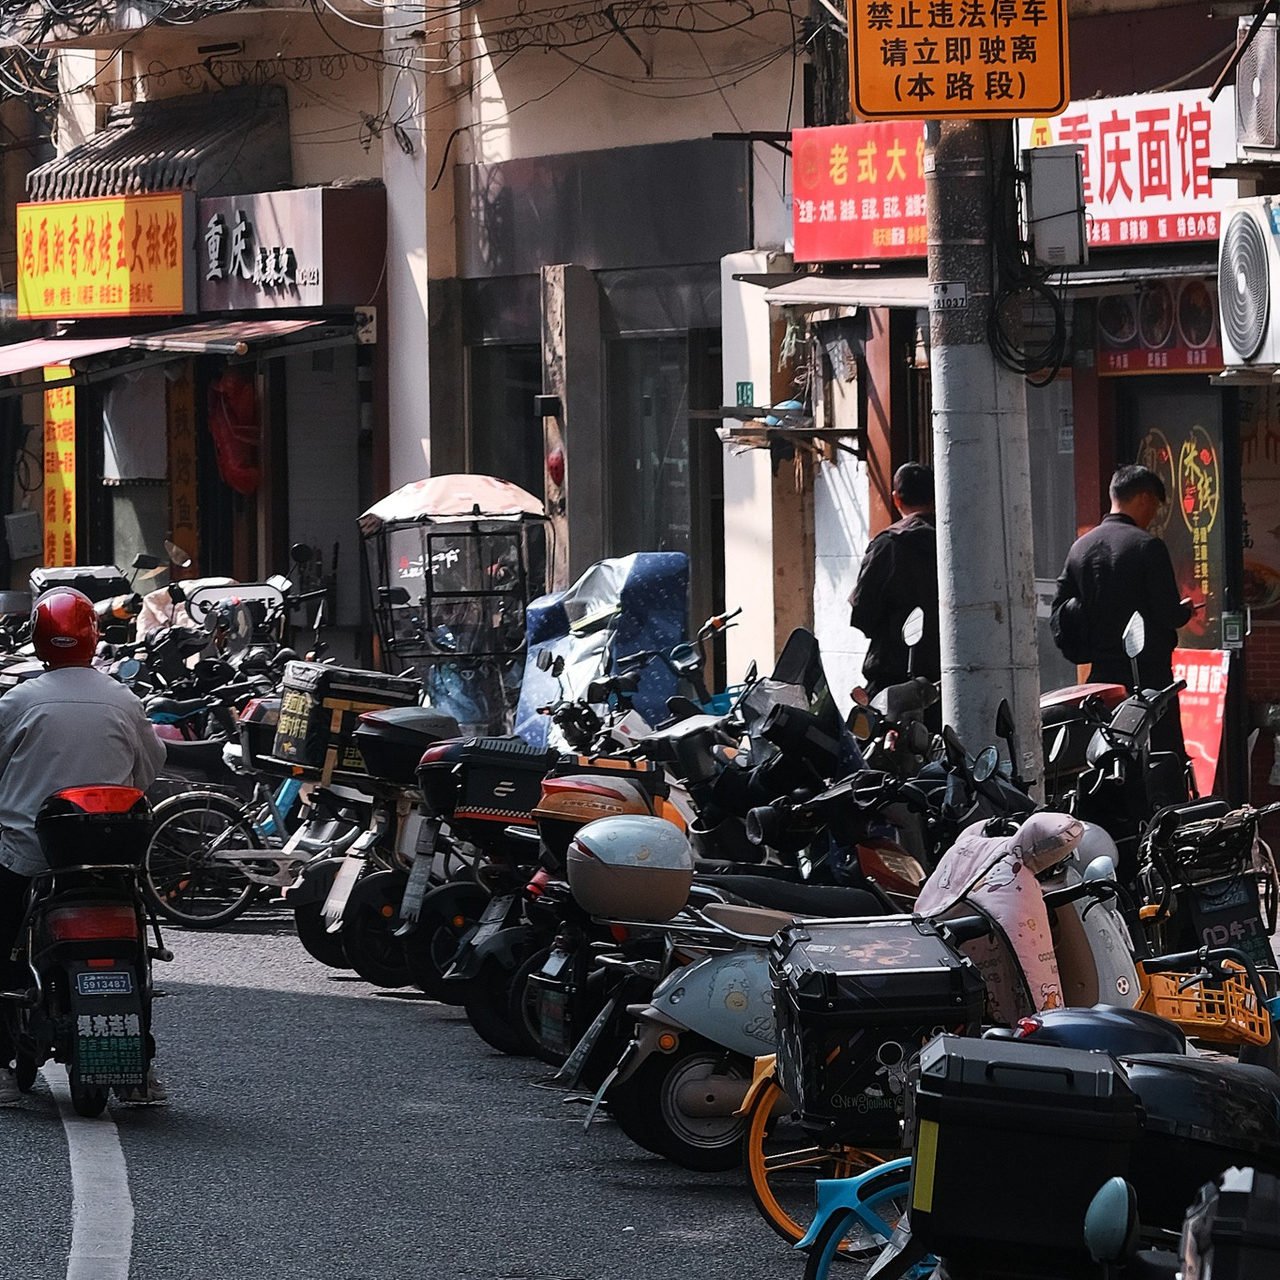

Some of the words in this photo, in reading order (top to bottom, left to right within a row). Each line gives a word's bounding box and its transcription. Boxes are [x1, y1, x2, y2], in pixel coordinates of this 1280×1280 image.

[880, 34, 1037, 67] 请立即驶离
[894, 70, 1026, 102] (本路段)
[1059, 101, 1213, 205] 重庆面馆
[1177, 215, 1217, 238] 特色小吃
[22, 208, 178, 279] 鸿雁湘香烧烤王大排档
[205, 210, 252, 281] 重庆
[83, 980, 126, 989] 5913487
